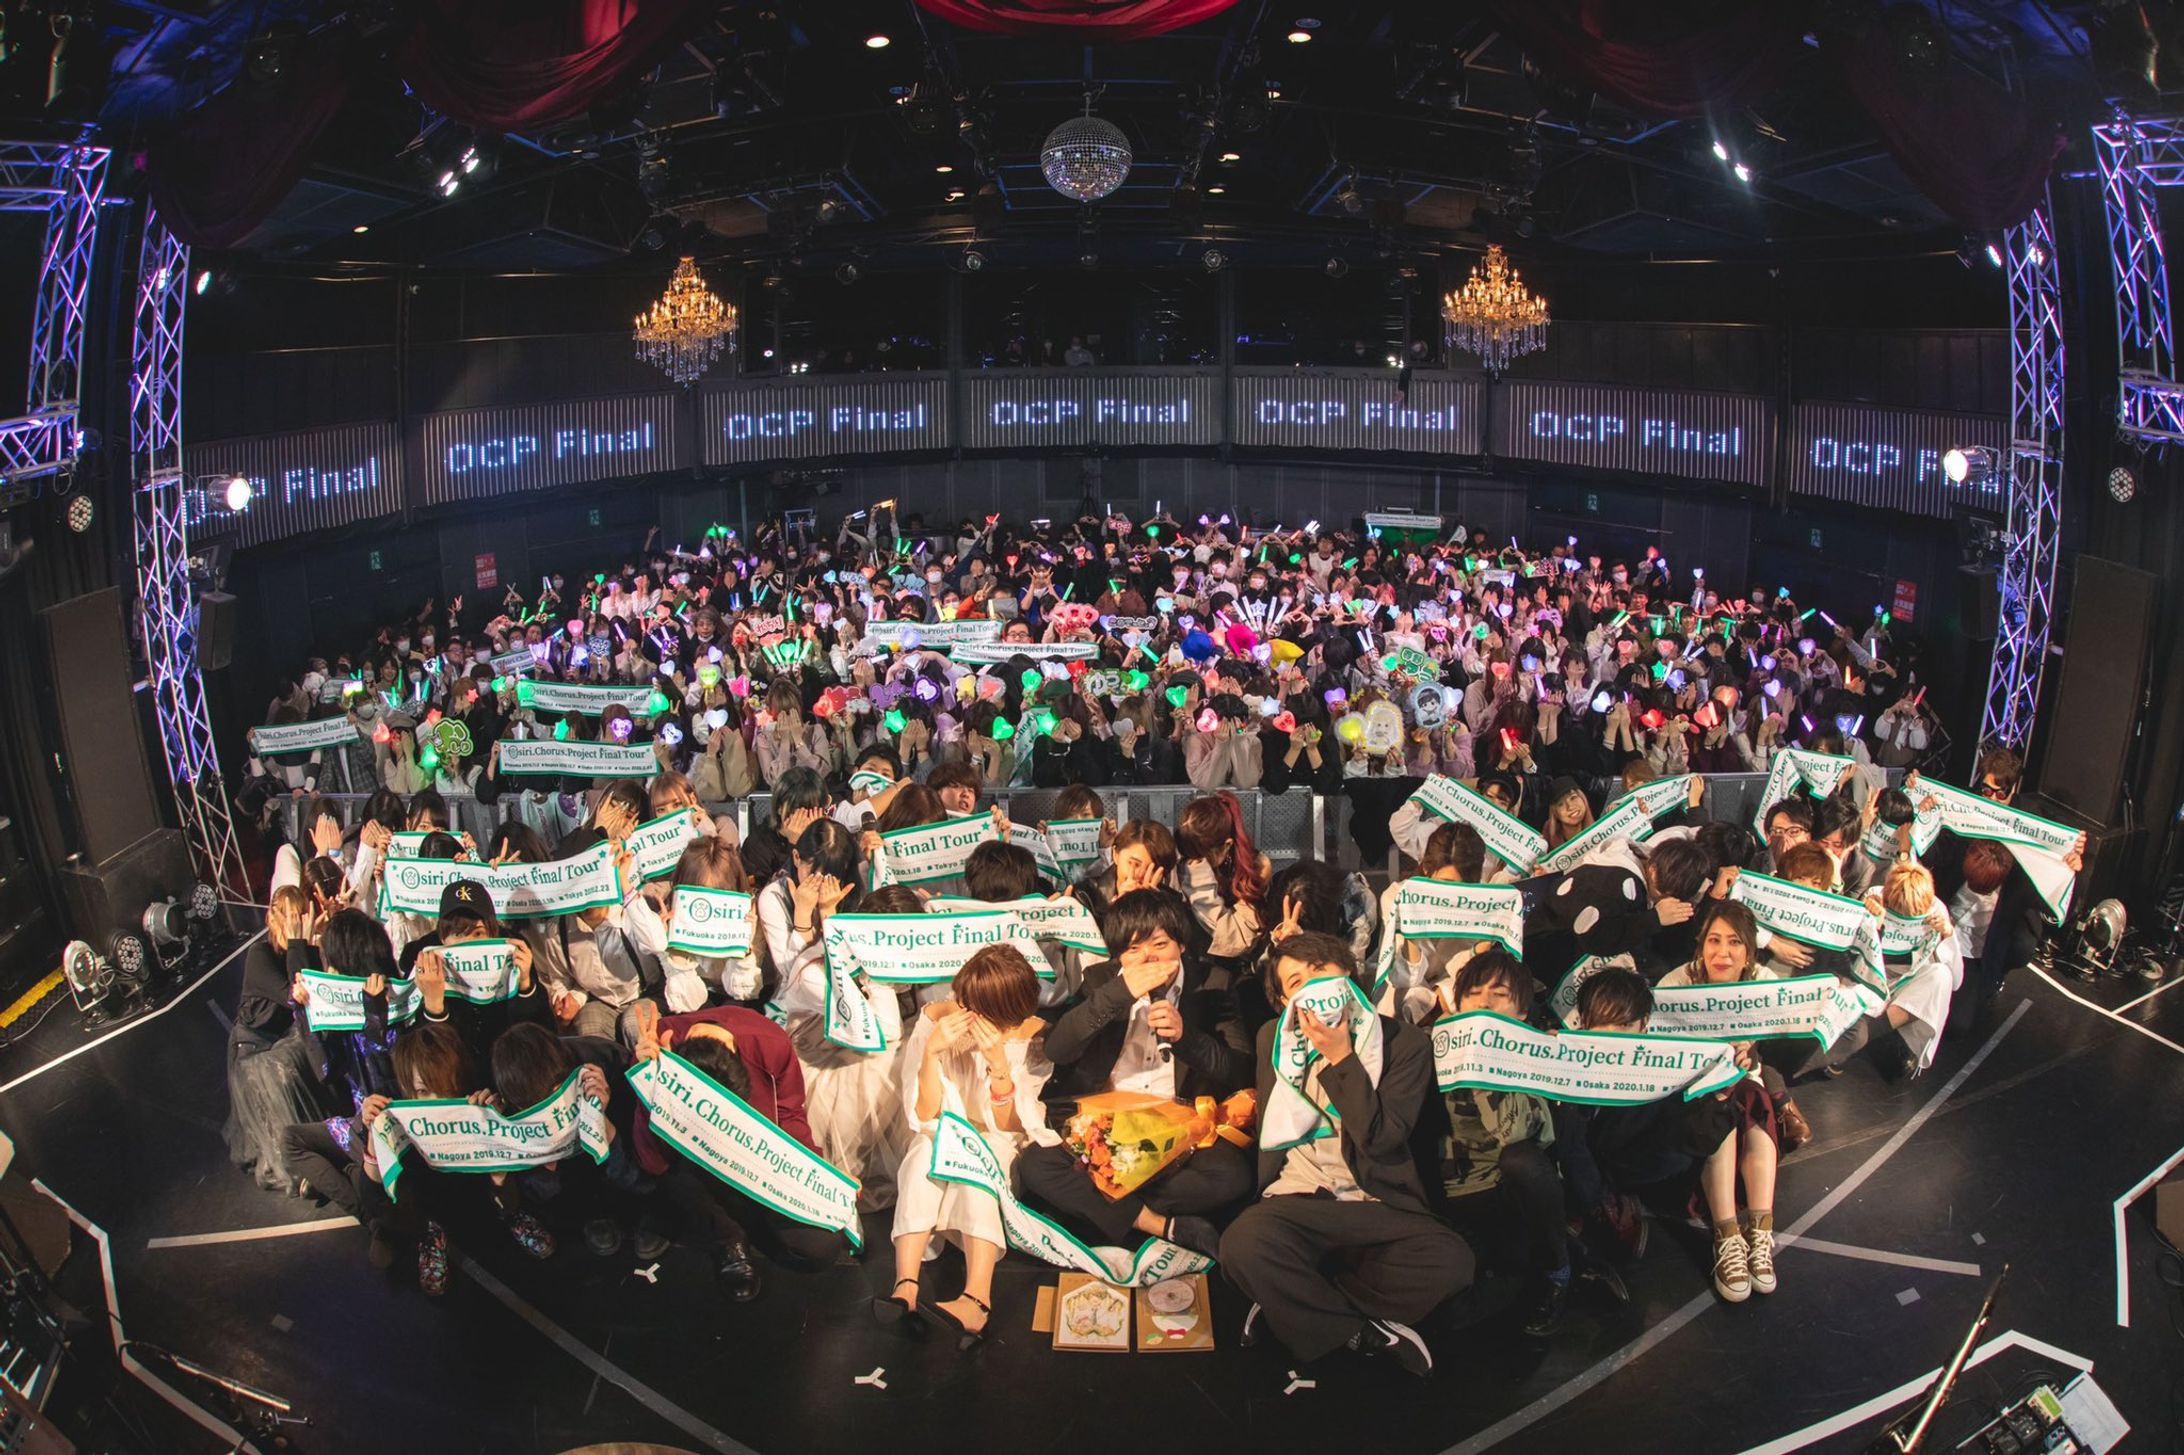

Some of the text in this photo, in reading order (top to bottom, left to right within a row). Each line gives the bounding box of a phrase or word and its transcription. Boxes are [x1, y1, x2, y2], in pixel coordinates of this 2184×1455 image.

[728, 402, 924, 440] OCP Final
[994, 399, 1187, 425] OCP Final
[1259, 400, 1455, 431] OCP Final
[1533, 411, 1740, 455] OCP Final
[447, 422, 652, 474] OCP Final
[1815, 437, 1901, 475] OCP
[285, 456, 378, 504] Final
[507, 744, 646, 761] Osiri.Chorus.Project Final Tour
[647, 826, 681, 847] Tour
[892, 831, 981, 858] Final Tour
[2041, 830, 2067, 846] Tour
[531, 865, 562, 885] Final
[565, 859, 601, 880] Tour
[682, 929, 715, 940] Fukuoka
[952, 923, 1001, 944] Final
[909, 961, 936, 969] Osaka
[1777, 987, 1822, 1006] Final
[1657, 1017, 1801, 1034] Nagoya 2019.12.7 Osaka 2020.1.18
[1432, 1026, 1625, 1069] Osiri.Chorus.Project
[1631, 1045, 1684, 1069] Final
[1496, 1067, 1528, 1079] Nagoya
[1530, 1072, 1571, 1087] 2019.12.7
[1583, 1081, 1610, 1090] Osaka
[1613, 1082, 1655, 1093] 2020.1.18
[438, 1150, 512, 1162] Nagoya 2019.12.7
[698, 1140, 729, 1165] Nagoya
[730, 1160, 760, 1183] 2019.12.7
[767, 1184, 787, 1201] Osaka
[804, 1168, 838, 1203] Final
